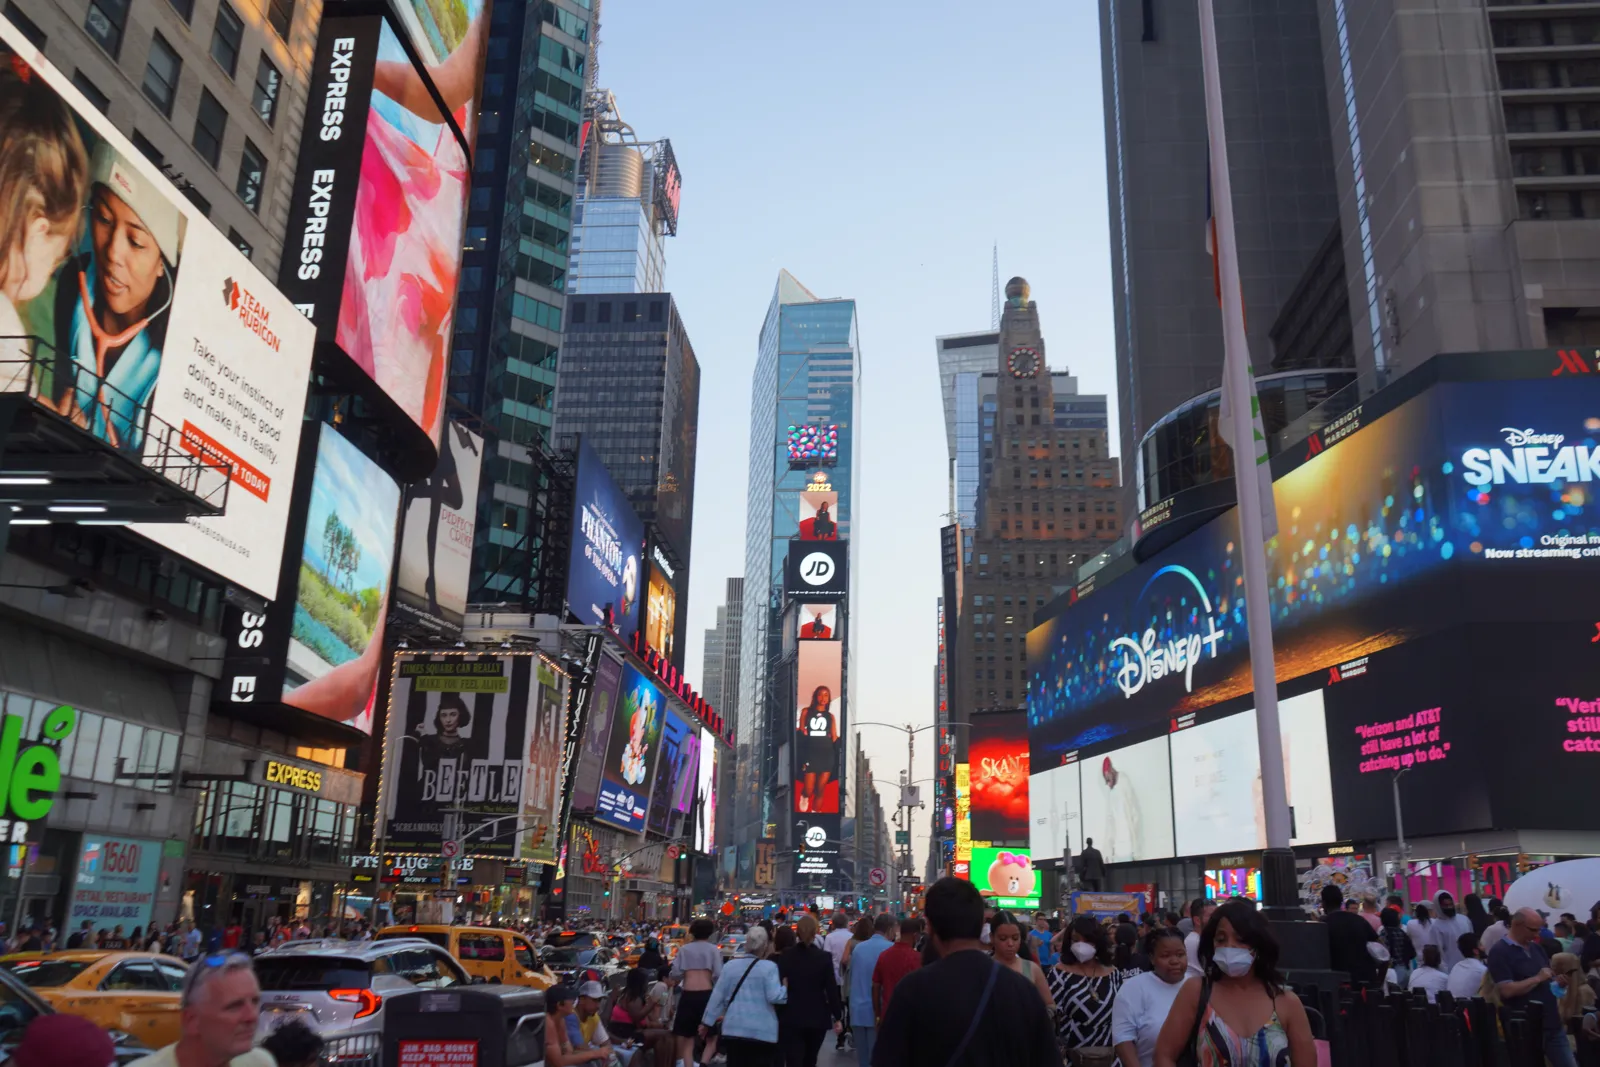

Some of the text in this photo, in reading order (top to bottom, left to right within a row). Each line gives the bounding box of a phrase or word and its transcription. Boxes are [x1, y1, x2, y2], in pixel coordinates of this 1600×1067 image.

[320, 37, 355, 141] EXPRESS
[298, 169, 335, 281] EXPRESS
[243, 288, 270, 325] TEAM
[239, 305, 280, 352] RUBICON
[193, 337, 285, 420] Take your instinct of
[188, 363, 281, 441] doing a simple good
[183, 387, 278, 465] and make it a reality.
[1324, 405, 1363, 436] MARRIOTT
[1325, 419, 1360, 446] MARQUIS
[1500, 427, 1565, 450] Disney
[1462, 445, 1600, 486] SNEAK
[240, 467, 268, 494] TODAY
[807, 483, 832, 492] 2022
[1141, 498, 1175, 520] MARRIOTT
[1485, 548, 1514, 559] Now
[1515, 545, 1582, 559] streaming
[1540, 535, 1587, 547] Original
[805, 561, 830, 577] JD
[402, 663, 500, 675] TIMES SQUARE CAN REALLY
[419, 678, 441, 689] MAKE
[443, 679, 458, 690] YOU
[460, 679, 479, 690] FEEL
[1395, 713, 1415, 731] and
[1415, 707, 1441, 727] AT&T
[1361, 725, 1440, 755] still have a lot of
[1359, 755, 1400, 773] catching
[1400, 753, 1414, 767] up
[1415, 748, 1427, 762] to
[266, 761, 322, 792] EXPRESS
[421, 763, 519, 802] BEETLE
[102, 841, 140, 873] 1560
[73, 904, 140, 918] SPACE AVAILABLE
[401, 1053, 475, 1062] KEEP THE FAITH
[443, 1044, 475, 1053] MONEY
